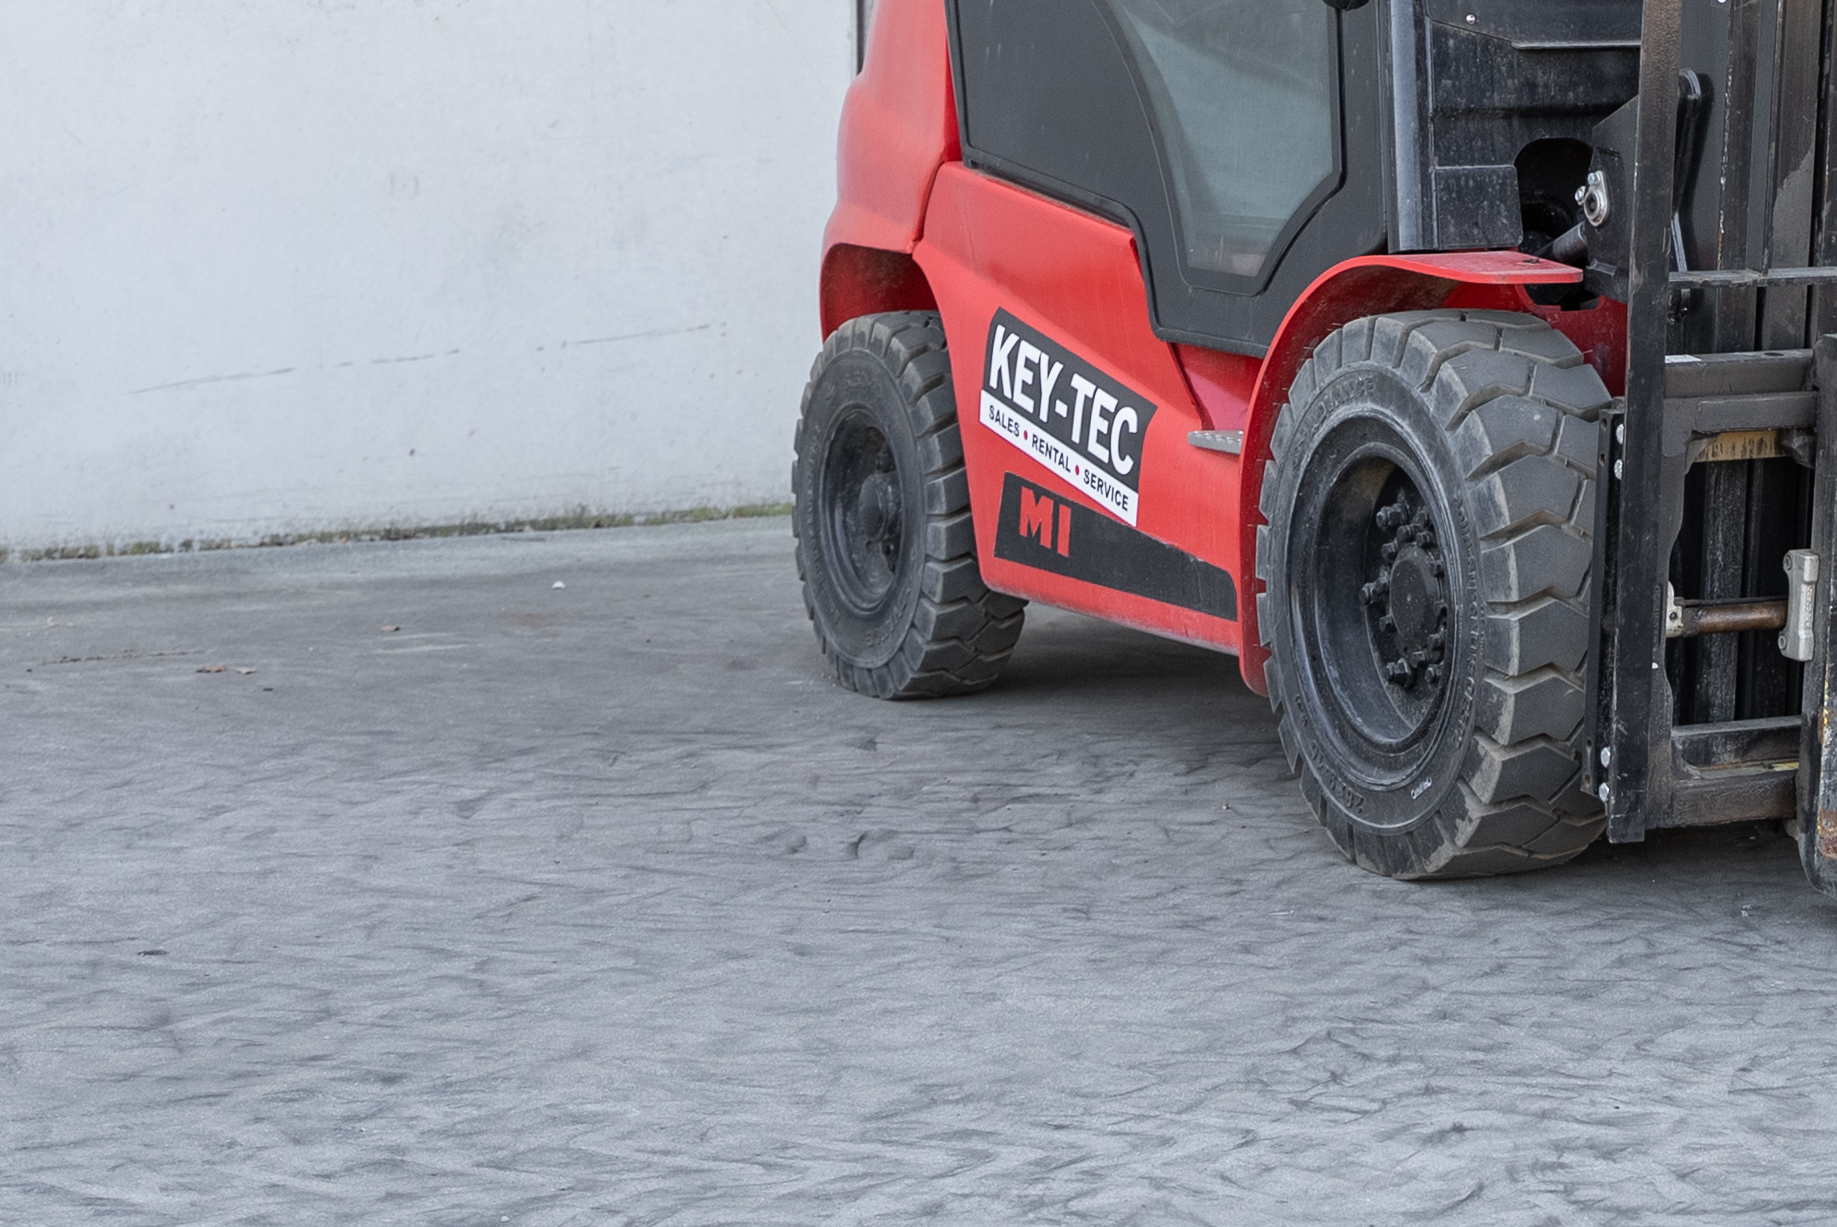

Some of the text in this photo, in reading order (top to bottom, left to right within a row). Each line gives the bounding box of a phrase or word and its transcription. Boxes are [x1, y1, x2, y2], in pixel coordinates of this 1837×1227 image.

[988, 324, 1139, 476] KEY-TEC
[988, 404, 1129, 512] SALES RENTAL SERVICE
[1019, 485, 1072, 558] MI
